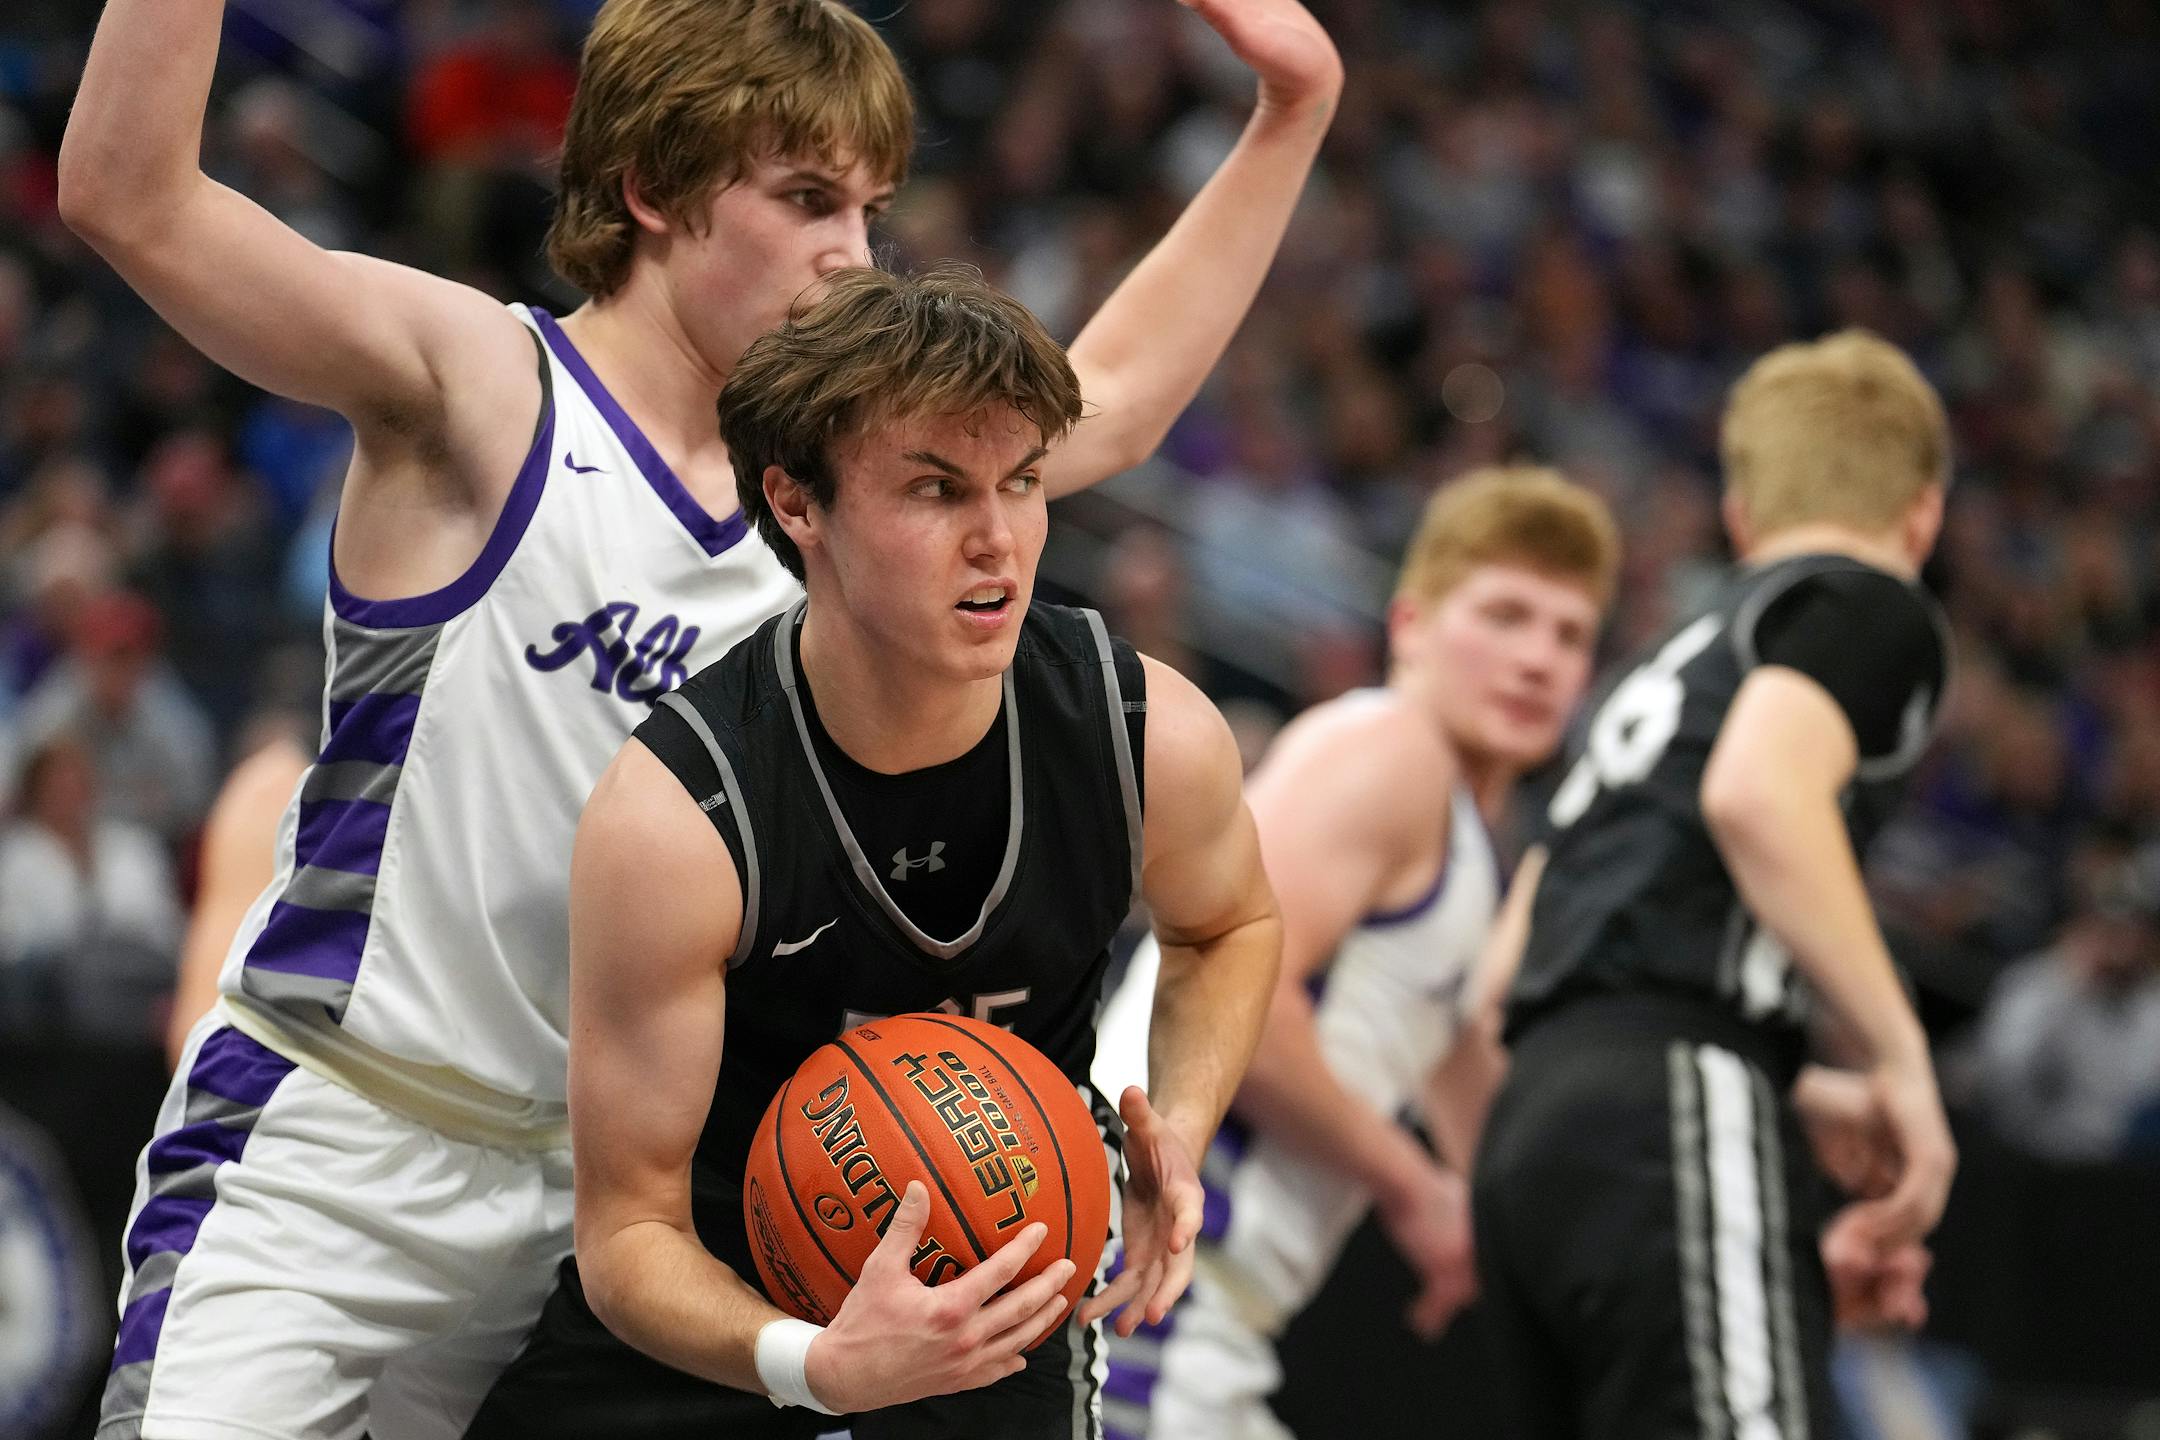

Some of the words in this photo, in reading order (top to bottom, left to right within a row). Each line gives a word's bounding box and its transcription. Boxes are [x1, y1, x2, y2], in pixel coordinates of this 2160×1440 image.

[936, 1051, 1022, 1151] 1000
[978, 1064, 997, 1084] BALL
[994, 1087, 1014, 1110] GAME
[891, 1051, 1026, 1233] LEGACY
